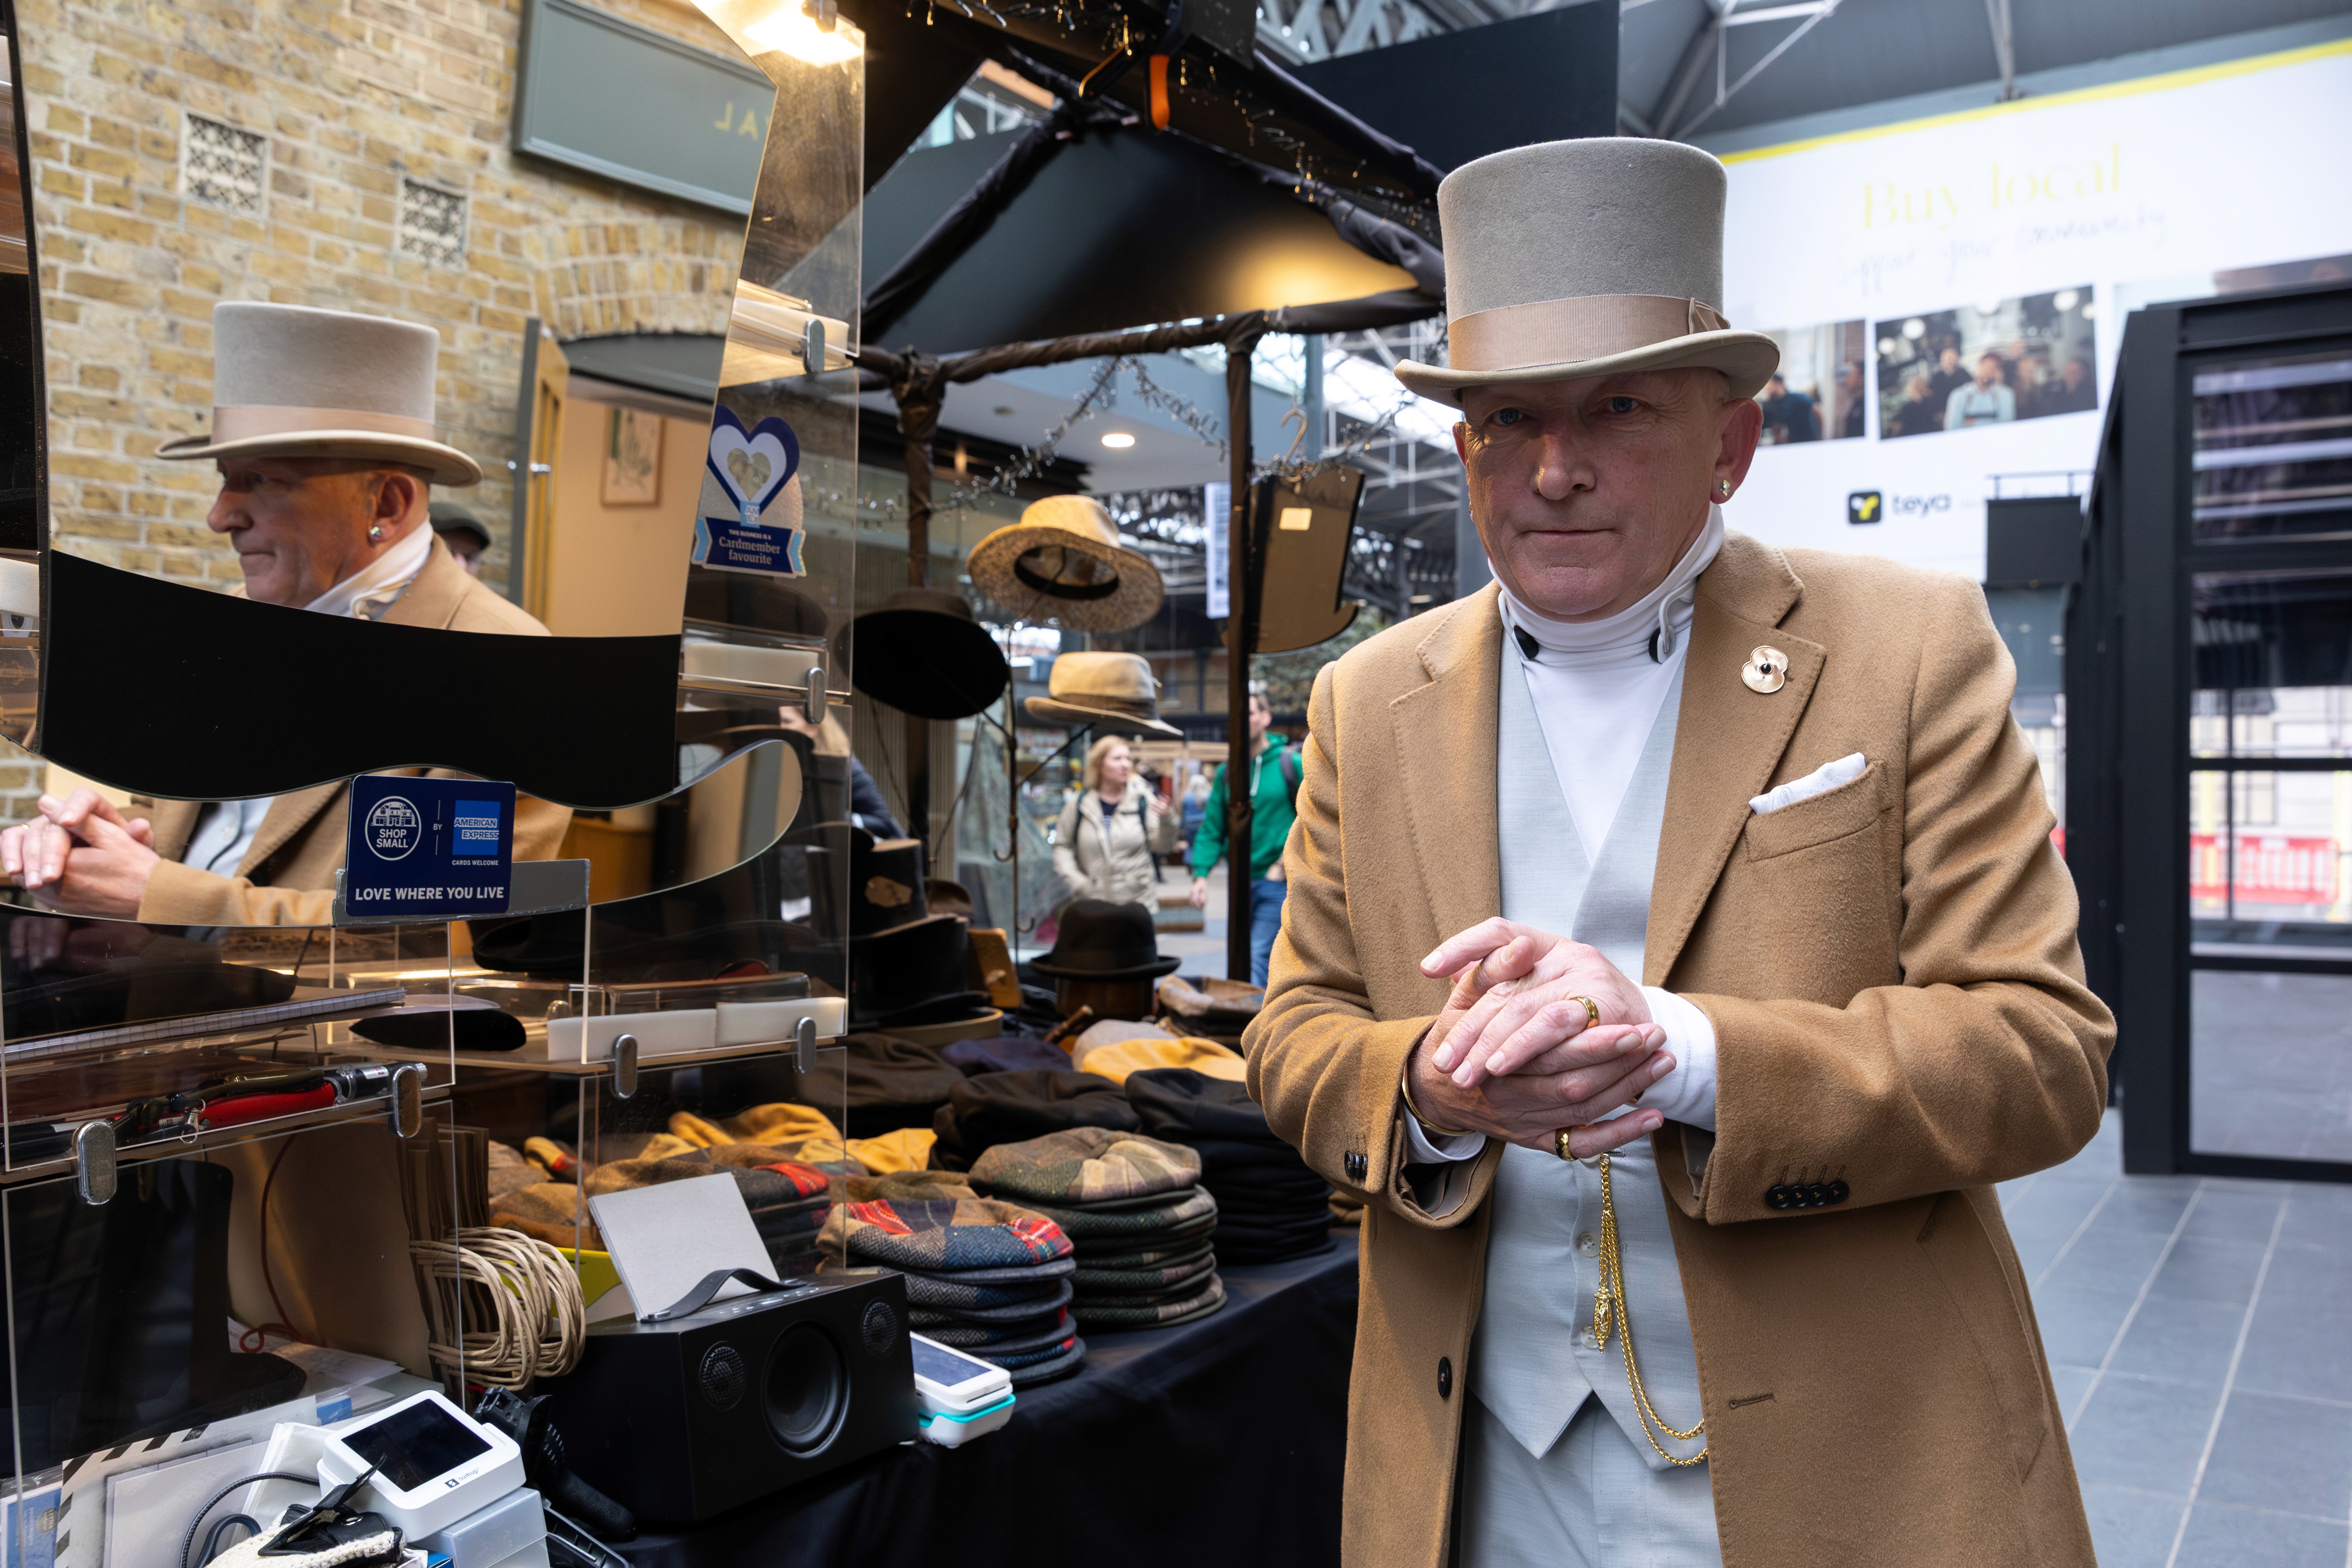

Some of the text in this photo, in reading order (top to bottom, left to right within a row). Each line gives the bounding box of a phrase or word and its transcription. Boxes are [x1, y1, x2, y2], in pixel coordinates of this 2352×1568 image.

[1863, 142, 2120, 230] Buy local
[1892, 494, 1951, 517] teya
[719, 536, 781, 554] Cardmember
[728, 549, 772, 565] favourite
[454, 817, 497, 828] AMERICAN
[379, 828, 407, 838] SHOP
[462, 829, 499, 839] EXPRESS
[376, 838, 408, 848] SMALL
[355, 887, 504, 900] LOVE WHERE YOU LIVE
[459, 1469, 478, 1480] sumup
